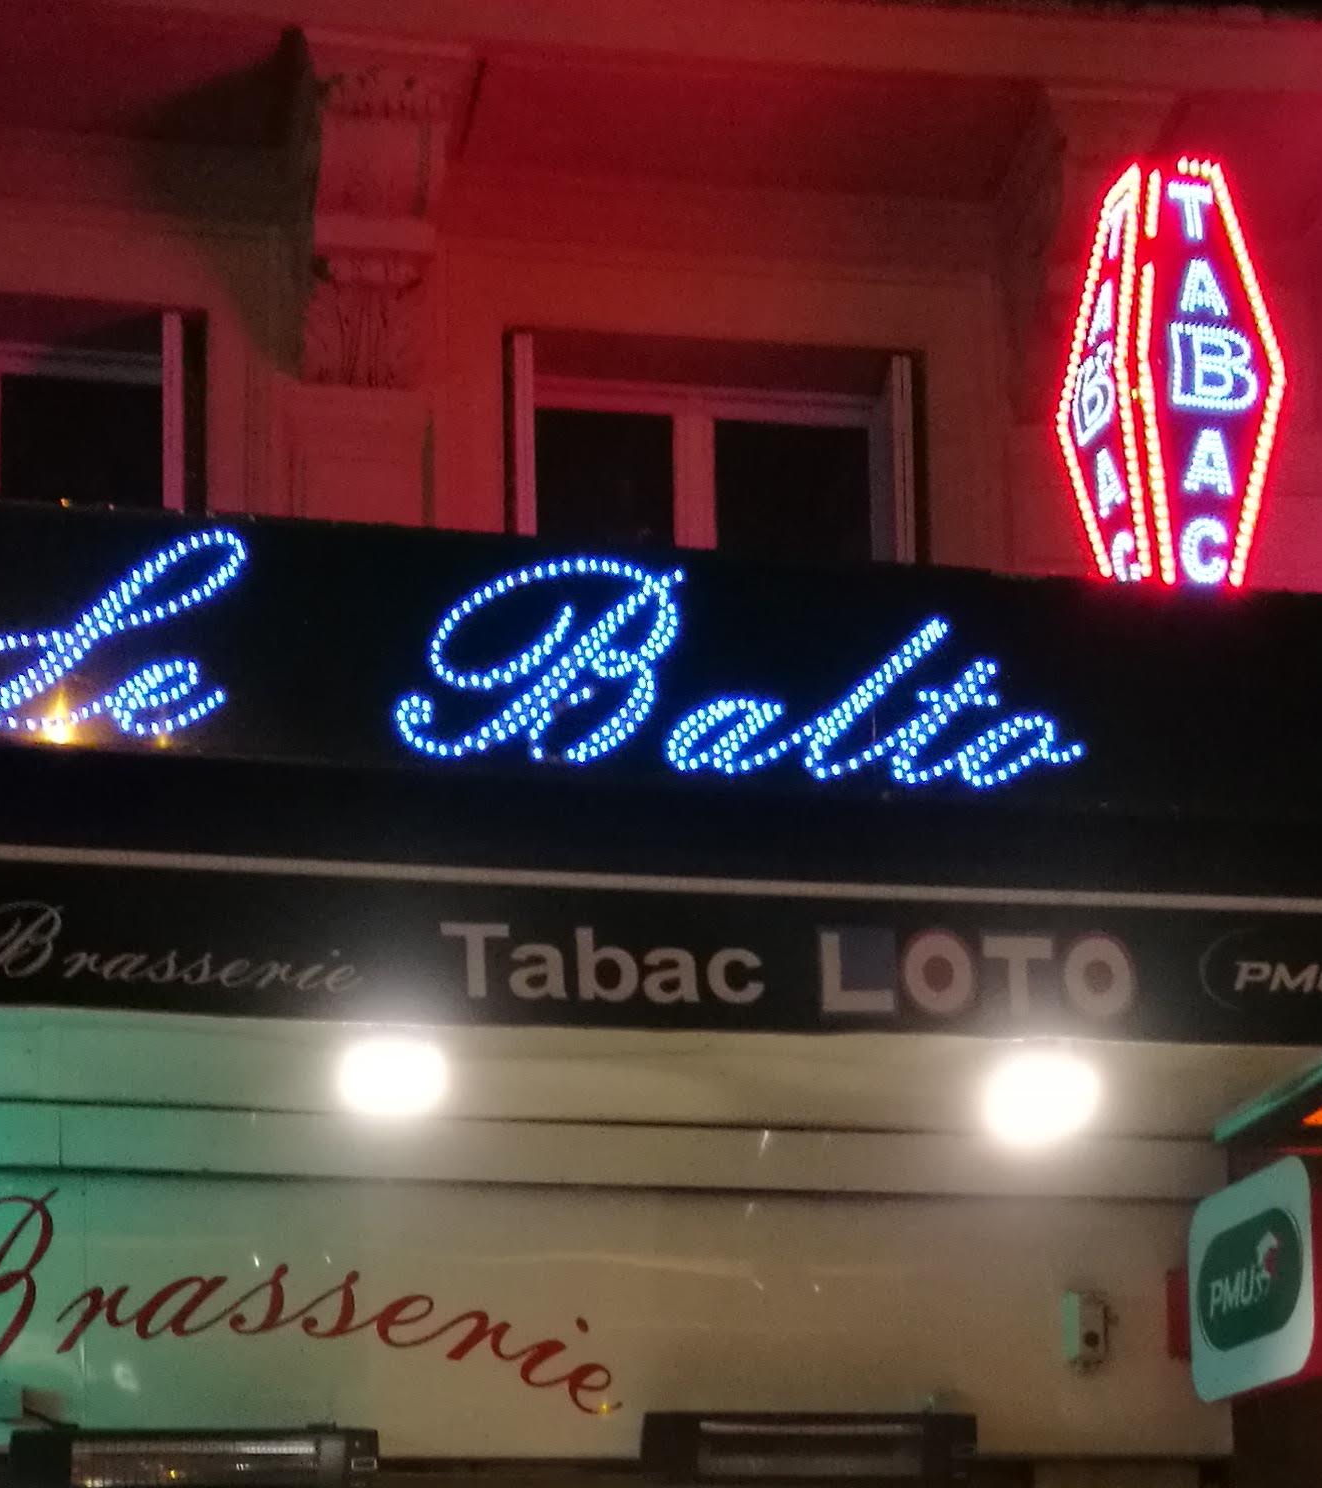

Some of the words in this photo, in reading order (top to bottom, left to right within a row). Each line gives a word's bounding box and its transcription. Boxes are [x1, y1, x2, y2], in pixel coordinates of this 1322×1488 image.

[1167, 181, 1257, 584] TABAC
[395, 555, 1086, 788] Balto
[440, 921, 765, 1004] Tabac
[817, 930, 1136, 1018] LOTO
[1209, 1265, 1256, 1320] PMU
